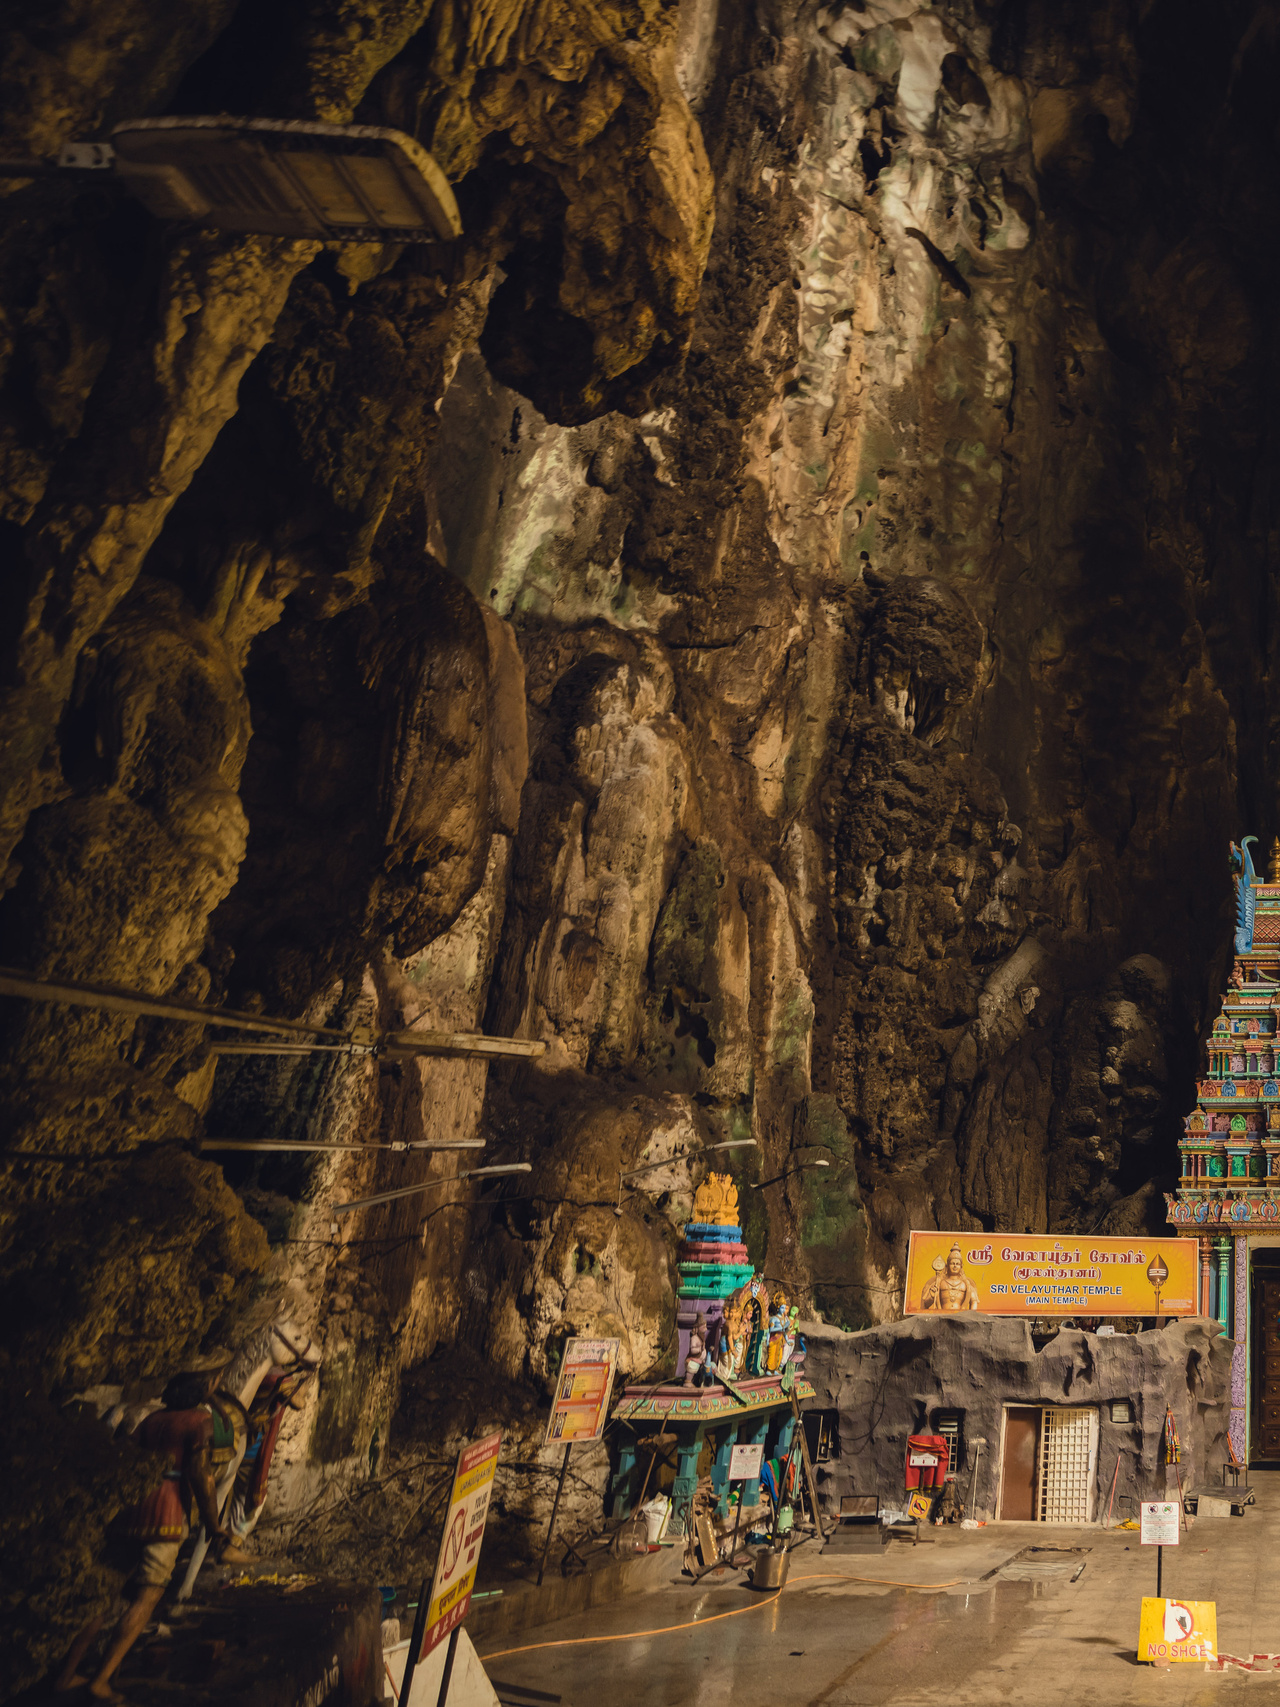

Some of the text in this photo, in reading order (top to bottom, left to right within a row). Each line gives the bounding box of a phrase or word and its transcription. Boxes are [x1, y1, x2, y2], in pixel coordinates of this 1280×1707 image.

[1089, 1249, 1146, 1264] கோவில்
[990, 1284, 1122, 1295] SRI VELAYUTHAR TEMPLE
[1025, 1296, 1088, 1307] (MAIN TEMPLE)
[1148, 1643, 1167, 1656] NO
